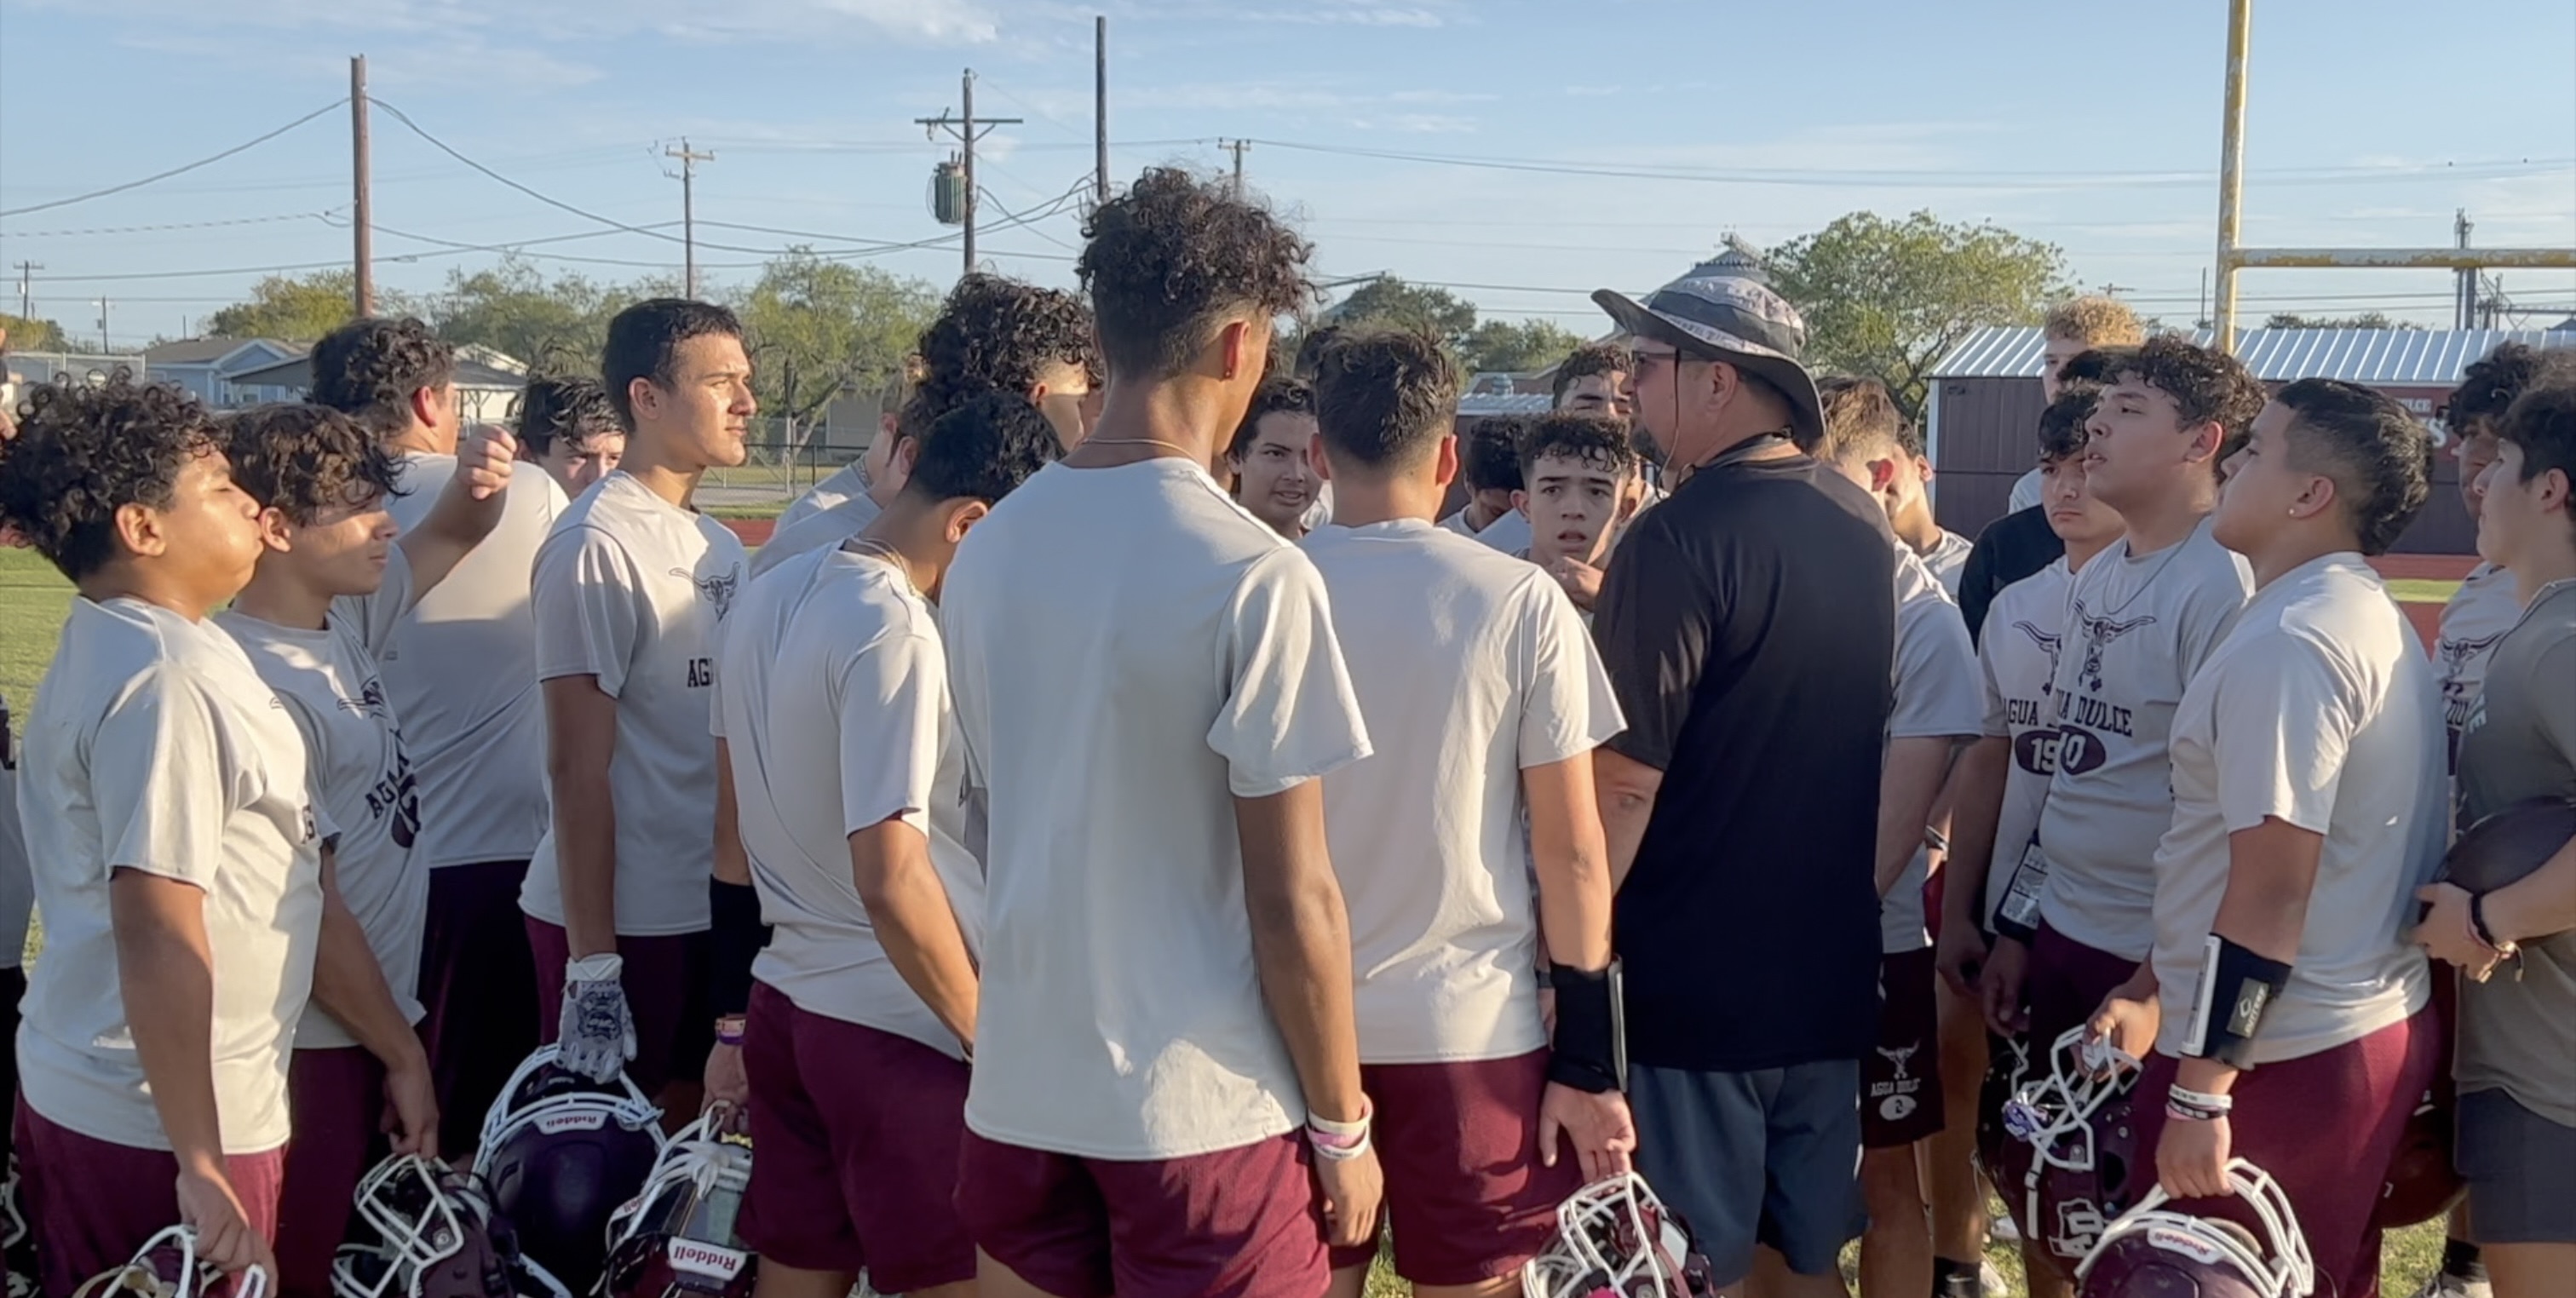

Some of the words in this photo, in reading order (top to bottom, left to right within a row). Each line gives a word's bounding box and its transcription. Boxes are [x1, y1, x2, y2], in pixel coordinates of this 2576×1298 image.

[687, 658, 714, 687] AG
[2004, 698, 2038, 726] GUA
[2074, 696, 2133, 738] DULCE
[546, 1115, 597, 1127] Riddell
[674, 1245, 737, 1271] Riddell
